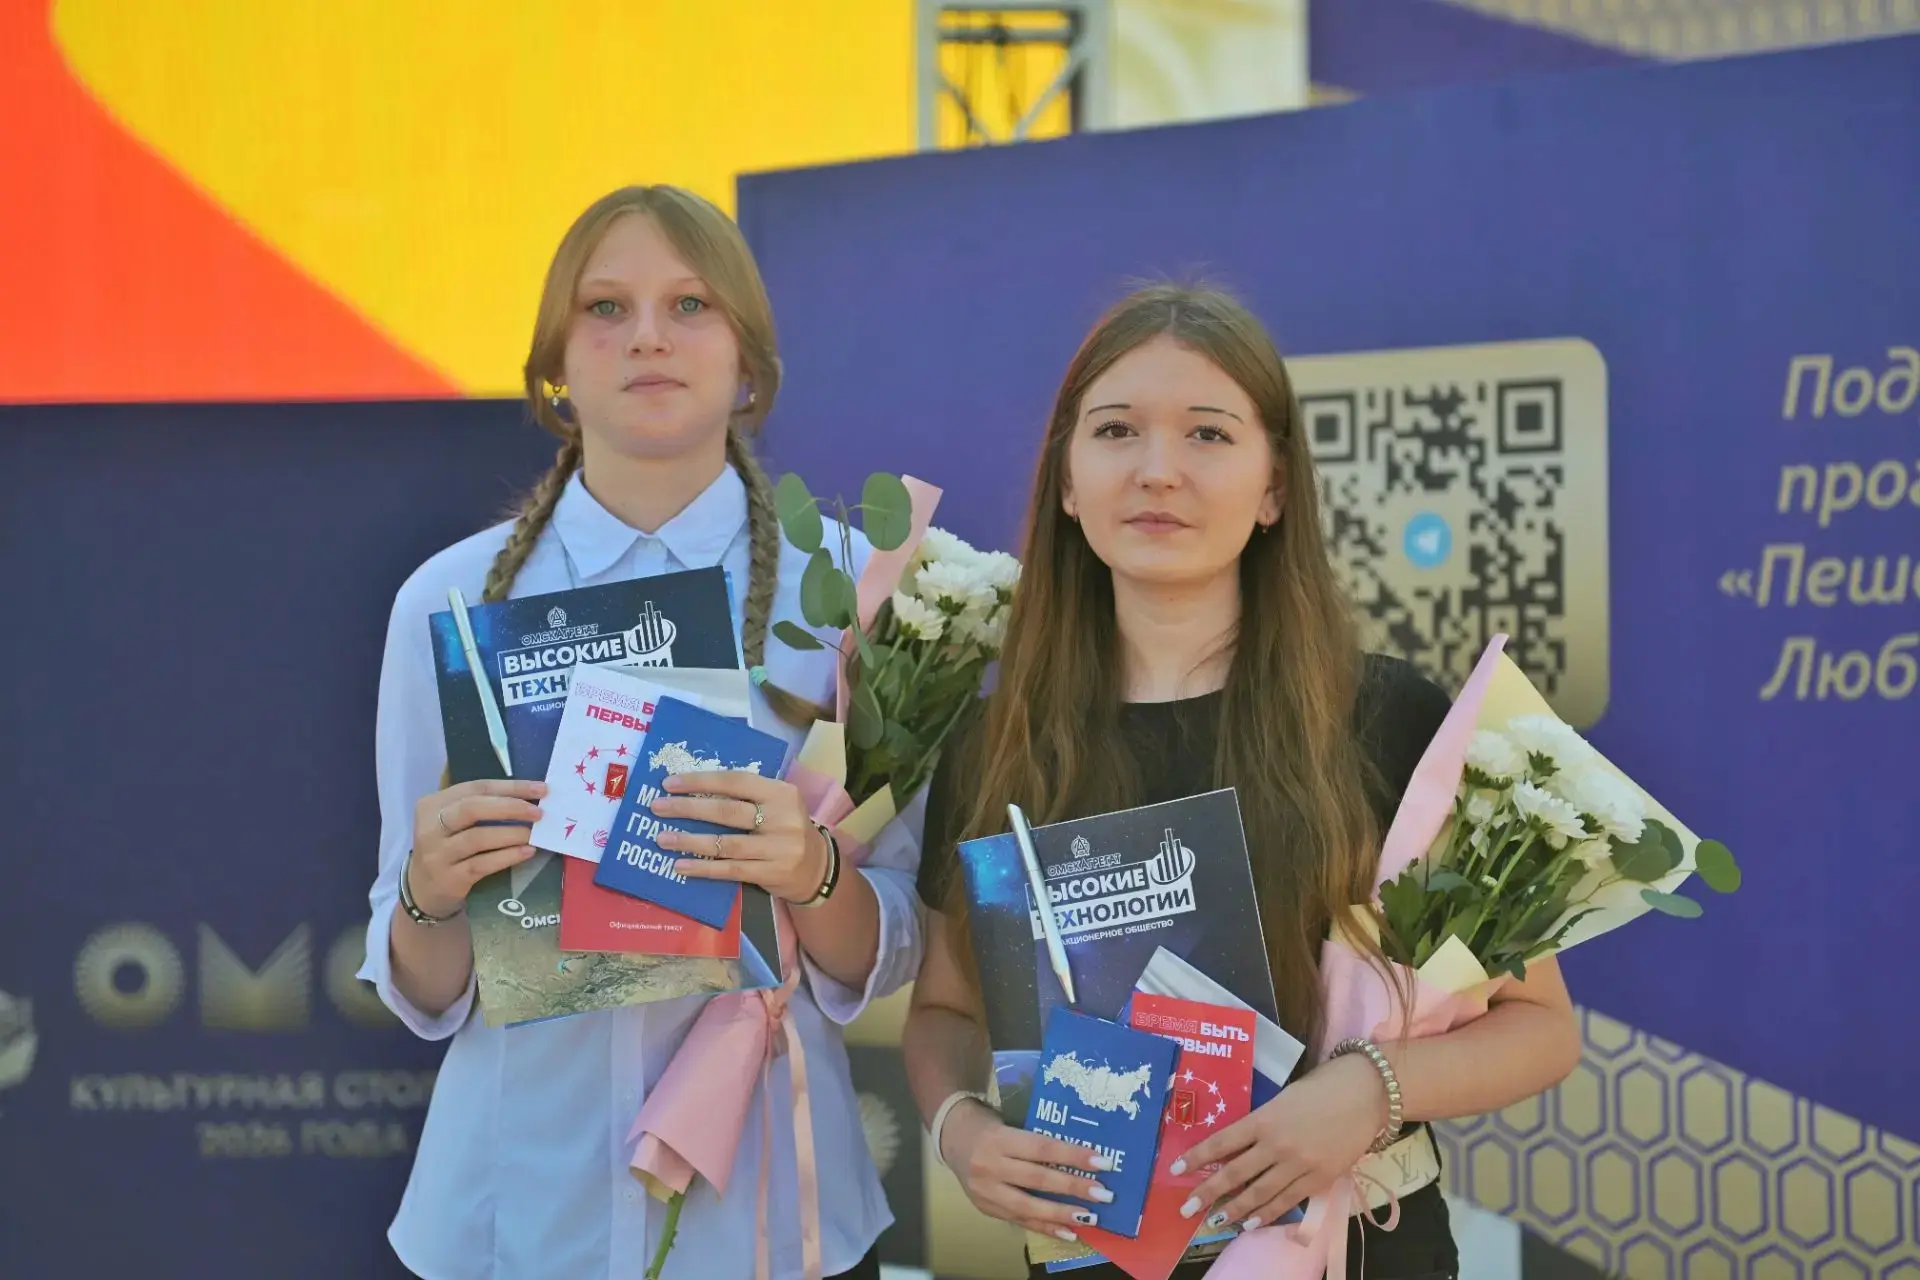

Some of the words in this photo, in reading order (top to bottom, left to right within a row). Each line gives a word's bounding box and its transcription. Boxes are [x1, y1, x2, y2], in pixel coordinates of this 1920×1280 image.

[1717, 543, 1920, 608] «Пеш
[522, 623, 599, 647] ОМСКАГРЕГАТ
[504, 637, 623, 675] ВЫСОКИЕ
[531, 700, 567, 713] АКЦИОН
[586, 704, 652, 733] ПЕРВЫ
[1047, 852, 1122, 878] ОМСКАГРЕГАТ
[1033, 867, 1146, 907] ЫСОКИЕ
[1125, 919, 1174, 935] ОБЩЕСТВО
[1135, 1011, 1198, 1034] ВРЕМЯ
[1200, 1021, 1250, 1042] БЫТЬ
[1035, 1097, 1069, 1126] МЫ
